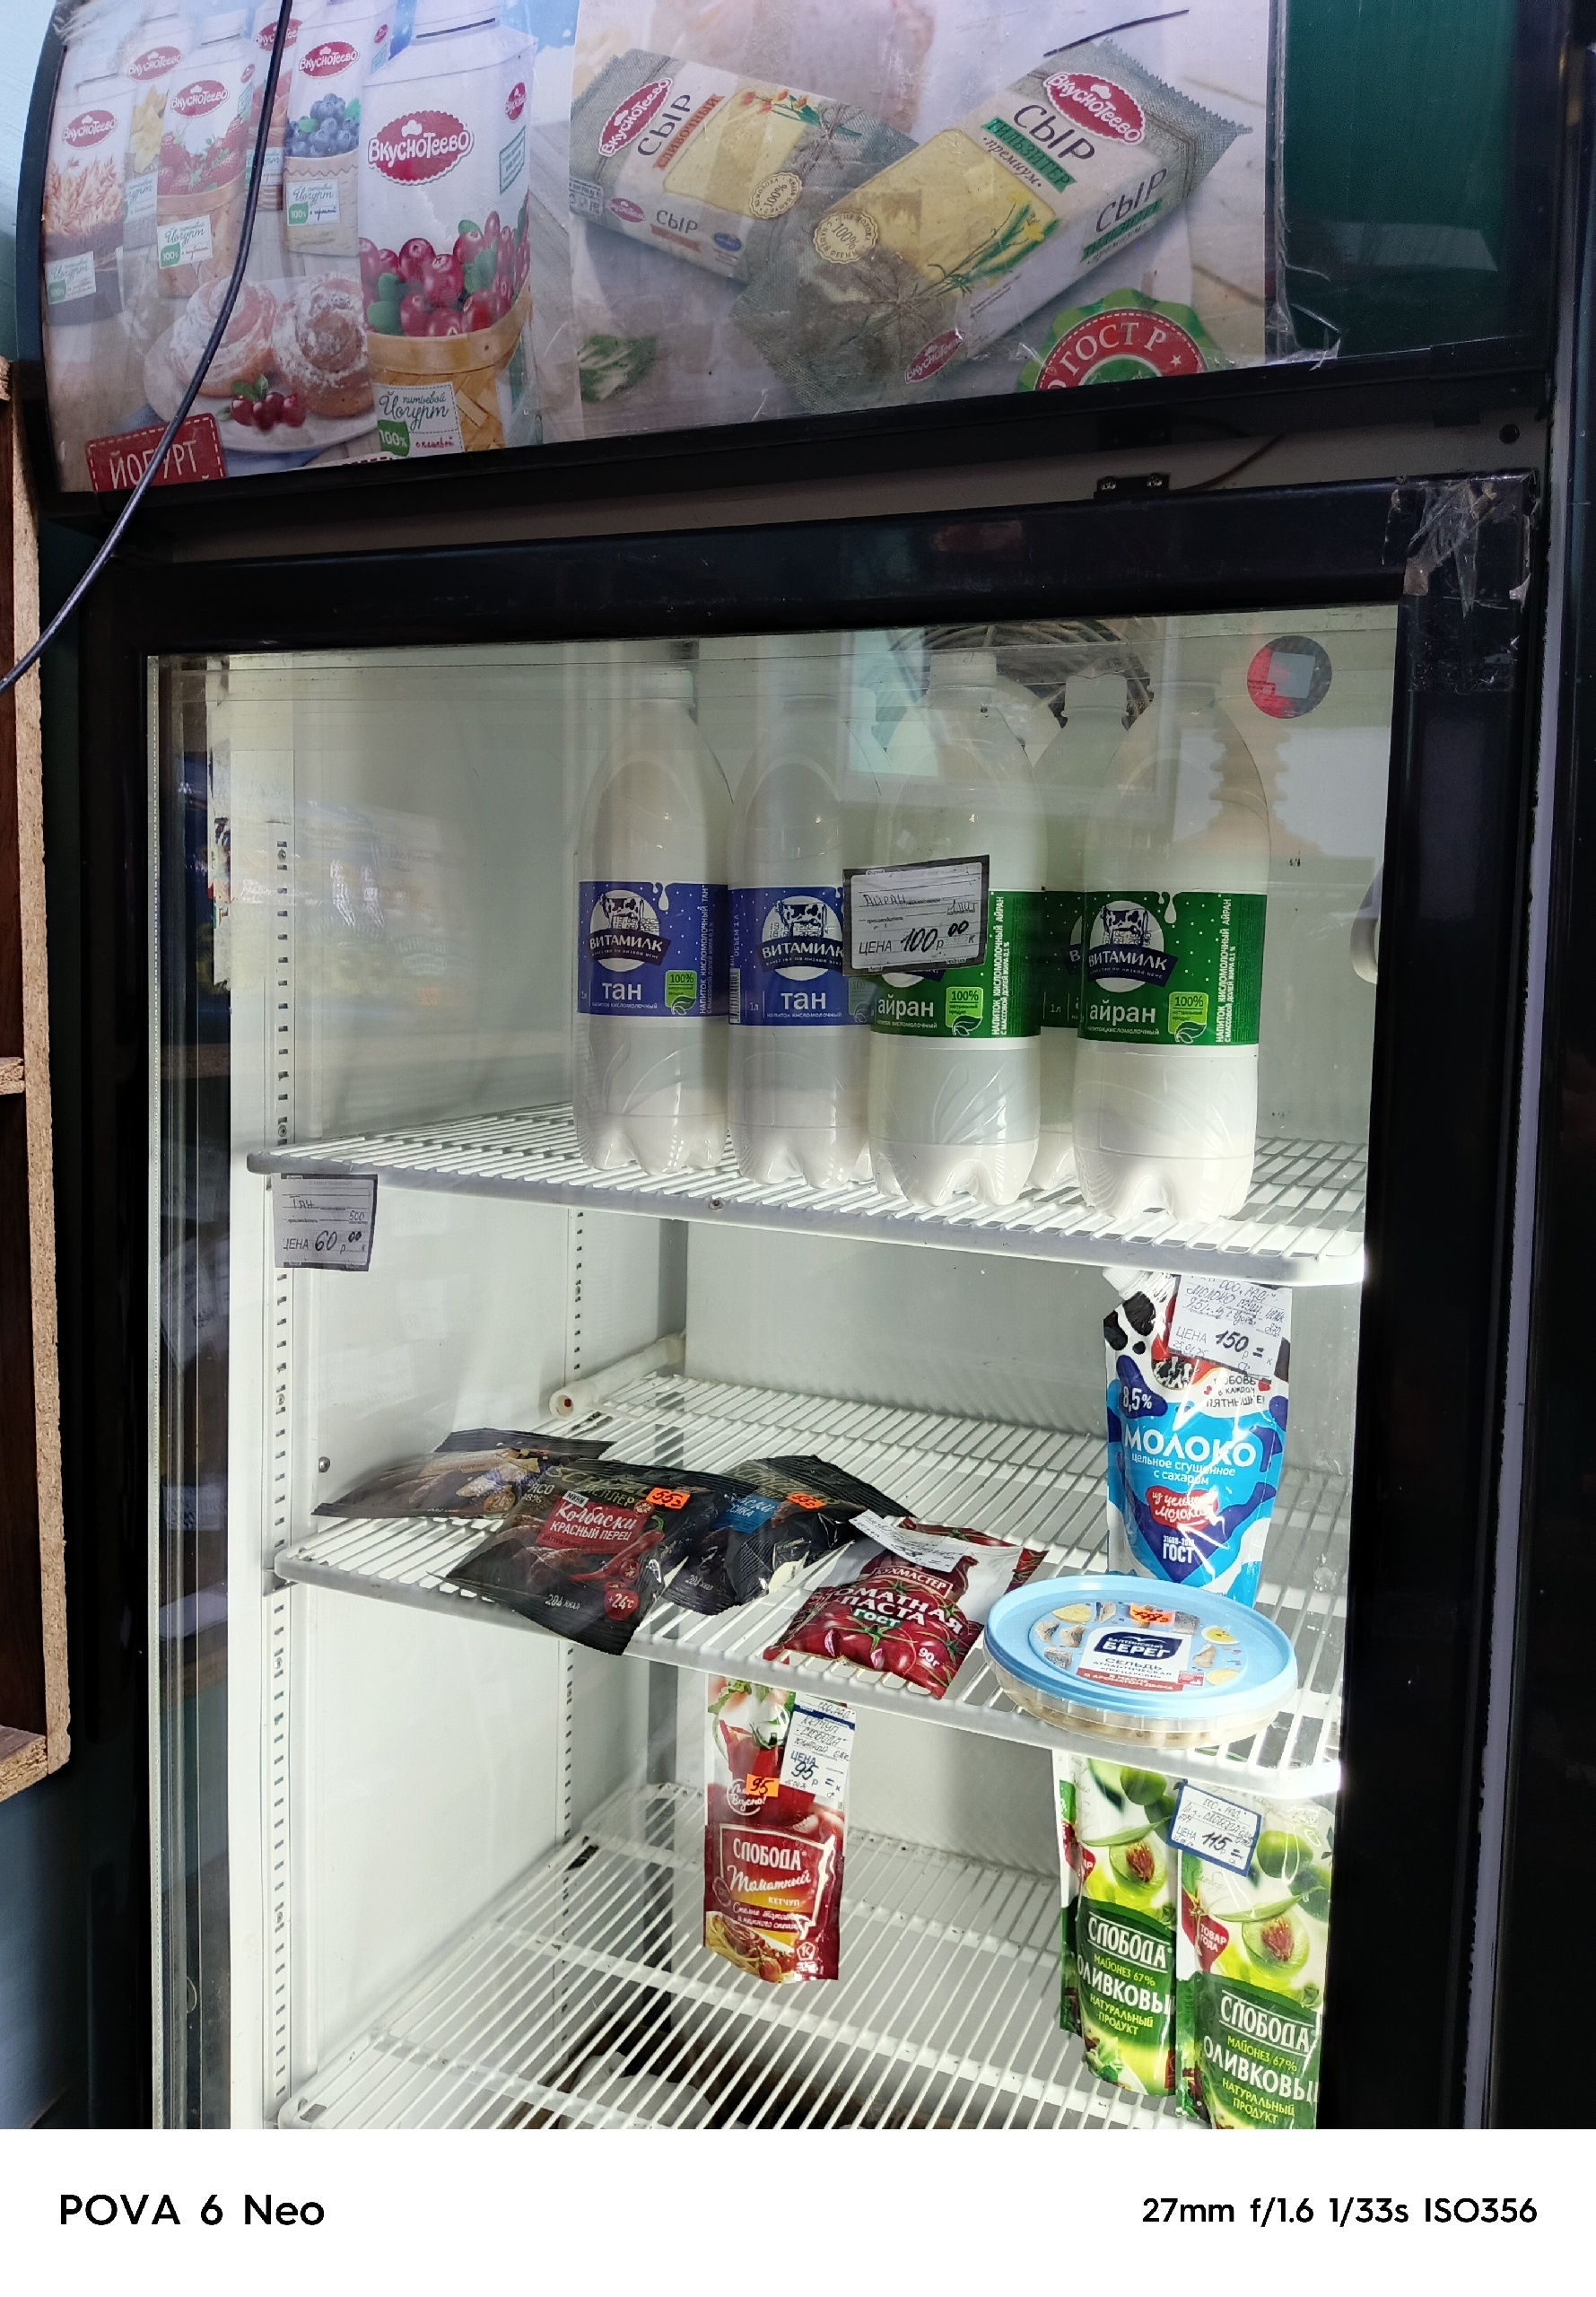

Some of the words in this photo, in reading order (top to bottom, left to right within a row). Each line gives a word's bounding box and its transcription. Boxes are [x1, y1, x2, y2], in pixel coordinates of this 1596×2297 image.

[637, 94, 691, 156] СЫР
[1014, 104, 1095, 160] СЫР
[763, 183, 788, 207] 100%
[1096, 168, 1167, 232] СЫР
[656, 209, 699, 234] СЫР
[831, 223, 859, 250] 100%
[1060, 322, 1139, 377] ГОСТ
[1144, 326, 1167, 352] Р
[379, 391, 449, 432] Йогурт
[379, 429, 408, 448] 100%
[994, 896, 1005, 922] АЙРАН
[1220, 898, 1232, 925] АЙРАН
[589, 934, 663, 952] ВИТАМИЛК
[762, 942, 844, 959] ВИТАМИЛК
[859, 940, 892, 956] ЦЕНА
[900, 928, 938, 953] 100
[947, 920, 970, 938] 00
[992, 924, 1004, 997] КИСЛОМОЛОЧНЫЙ
[1088, 950, 1168, 971] ВИТАМИЛК
[1217, 928, 1230, 1003] КИСЛОМОЛОЧНЫЙ
[602, 983, 641, 1000] тан
[670, 974, 694, 983] 100%
[781, 991, 826, 1010] тан
[877, 993, 934, 1020] айран
[951, 990, 979, 1001] 100%
[1050, 1003, 1061, 1013] 1л
[1174, 995, 1204, 1007] 100%
[991, 999, 1001, 1035] НАПИТОК
[1089, 999, 1156, 1026] айран
[1216, 1005, 1225, 1043] НАПИТОК
[315, 1230, 337, 1252] 60
[1175, 1326, 1208, 1344] ЦЕНА
[1215, 1330, 1250, 1353] 150
[1122, 1386, 1153, 1413] 8,5%
[1124, 1423, 1257, 1468] МОЛОКО
[1131, 1453, 1173, 1469] цельное
[1162, 1472, 1209, 1485] сахаром
[566, 1492, 586, 1505] МИНИ
[555, 1502, 638, 1530] Колбаски
[549, 1520, 600, 1538] КРАСНЫЙ
[599, 1529, 632, 1542] ПЕРЕЦ
[1163, 1542, 1195, 1564] ГОСТ
[840, 1595, 926, 1626] ПАСТА
[853, 1608, 901, 1628] ГОСТ
[1102, 1641, 1171, 1658] БЕРЕГ
[1093, 1661, 1173, 1676] АТЛАНТИЧЕСКАЯ
[1104, 1657, 1163, 1671] СЕЛЬДЬ
[790, 1750, 817, 1765] ЦЕНА
[790, 1760, 820, 1781] 95
[750, 1777, 775, 1795] 95
[1175, 1825, 1197, 1841] ЦЕНА
[1201, 1831, 1233, 1851] 115
[733, 1837, 802, 1871] СЛОБОДА
[727, 1865, 812, 1893] Томатный
[768, 1896, 800, 1907] КЕТЧУП
[1088, 1917, 1167, 1969] СЛОБОДА
[1199, 1924, 1227, 1945] ТОВАР
[1199, 1934, 1218, 1952] ГОДА
[1094, 1953, 1131, 1978] МАЙОНЕЗ
[1133, 1972, 1156, 1987] 67%
[1089, 1993, 1154, 2028] НАТУРАЛЬНЫЙ
[1098, 2011, 1139, 2036] ПРОДУКТ
[1220, 1996, 1311, 2054] СЛОБОДА
[1227, 2035, 1270, 2063] МАЙОНЕЗ
[1272, 2056, 1297, 2073] 67%
[1222, 2077, 1295, 2117] НАТУРАЛЬНЫЙ
[1233, 2097, 1279, 2125] ПРОДУКТ
